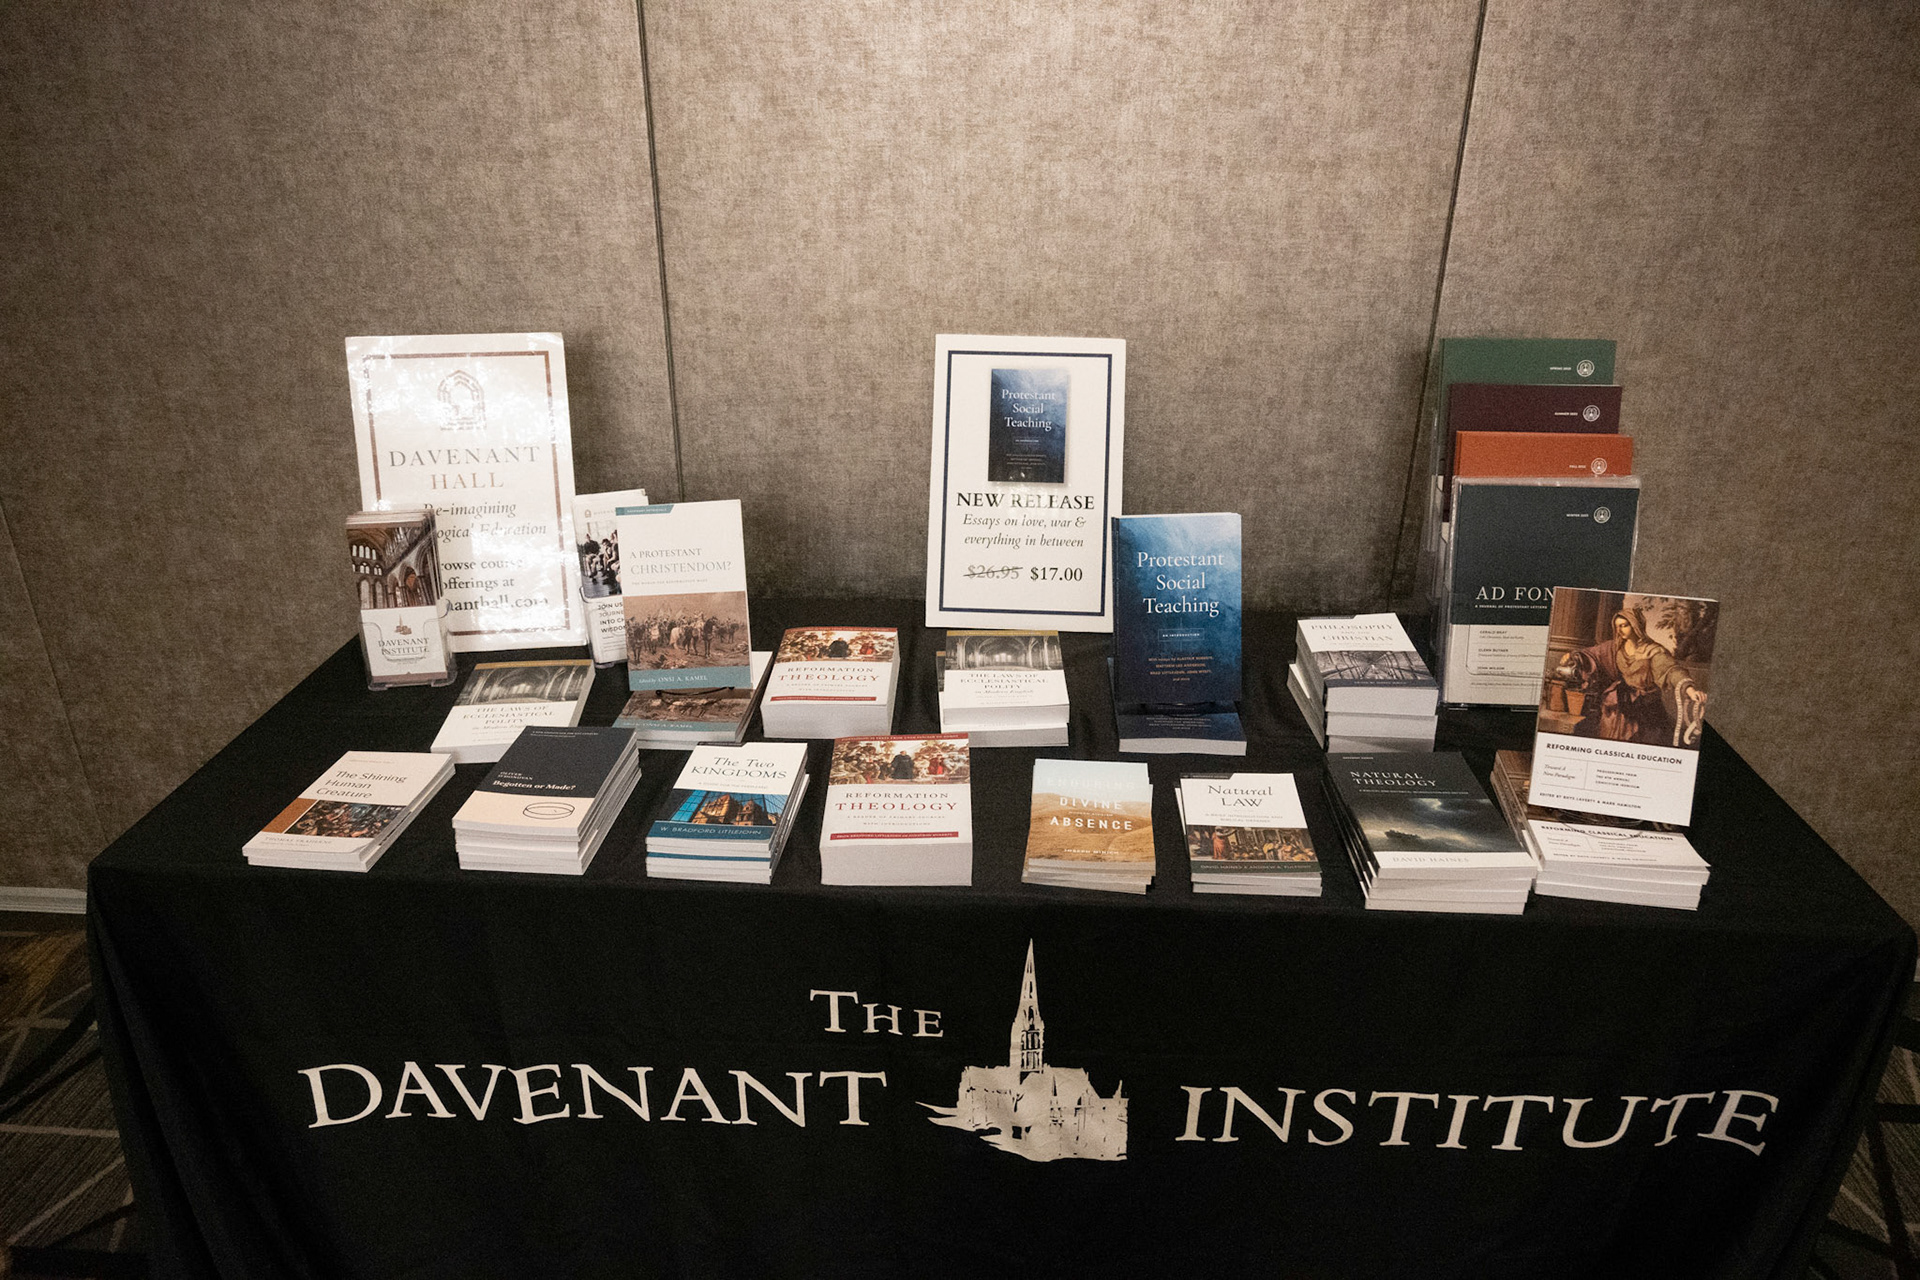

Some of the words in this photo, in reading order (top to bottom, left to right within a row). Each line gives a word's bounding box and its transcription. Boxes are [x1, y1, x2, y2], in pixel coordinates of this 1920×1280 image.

[1001, 388, 1056, 400] Protestant
[1012, 402, 1044, 414] Social
[1004, 416, 1052, 431] Teaching
[389, 445, 541, 467] DAVENANT
[430, 472, 505, 490] HALL
[956, 492, 1004, 508] NEW
[1010, 494, 1095, 510] RELEASE
[962, 514, 1000, 530] Essays
[1004, 518, 1018, 526] on
[1022, 514, 1047, 528] love,
[1050, 518, 1072, 528] war
[1074, 516, 1087, 528] &
[964, 533, 1022, 550] everything
[1025, 536, 1036, 546] in
[1040, 534, 1084, 547] between
[630, 551, 637, 559] A
[639, 548, 702, 559] PROTESTANT
[1136, 552, 1225, 568] Protestant
[630, 561, 732, 576] CHRISTENDOM?
[965, 565, 1021, 580] $26.95
[1030, 566, 1084, 581] $17.00
[502, 578, 514, 588] at
[1156, 572, 1206, 590] Social
[1476, 586, 1506, 600] AD
[1142, 595, 1220, 618] Teaching
[378, 637, 430, 648] DAVENANT
[381, 646, 430, 656] INSTITUTE
[1546, 743, 1592, 754] REFORMING
[1594, 748, 1635, 759] CLASSICAL
[1637, 754, 1682, 765] EDUCATION
[714, 756, 740, 766] The
[746, 758, 775, 768] Two
[336, 770, 358, 779] The
[360, 772, 408, 784] Shining
[690, 766, 788, 779] KINGDOMS
[324, 780, 372, 789] Human
[492, 780, 532, 789] Begotten
[1352, 778, 1437, 787] THEOLOGY
[316, 788, 373, 798] Creature
[1208, 785, 1273, 796] Natural
[834, 802, 958, 812] THEOLOGY
[1060, 796, 1122, 810] DIVINE
[1221, 798, 1262, 808] LAW
[1050, 816, 1132, 830] ABSENCE
[1541, 826, 1586, 834] REFORMING
[1588, 830, 1628, 838] CLASSICAL
[809, 988, 943, 1037] THE
[297, 1061, 887, 1129] DAVENANT
[1174, 1085, 1779, 1156] INSTITUTE
